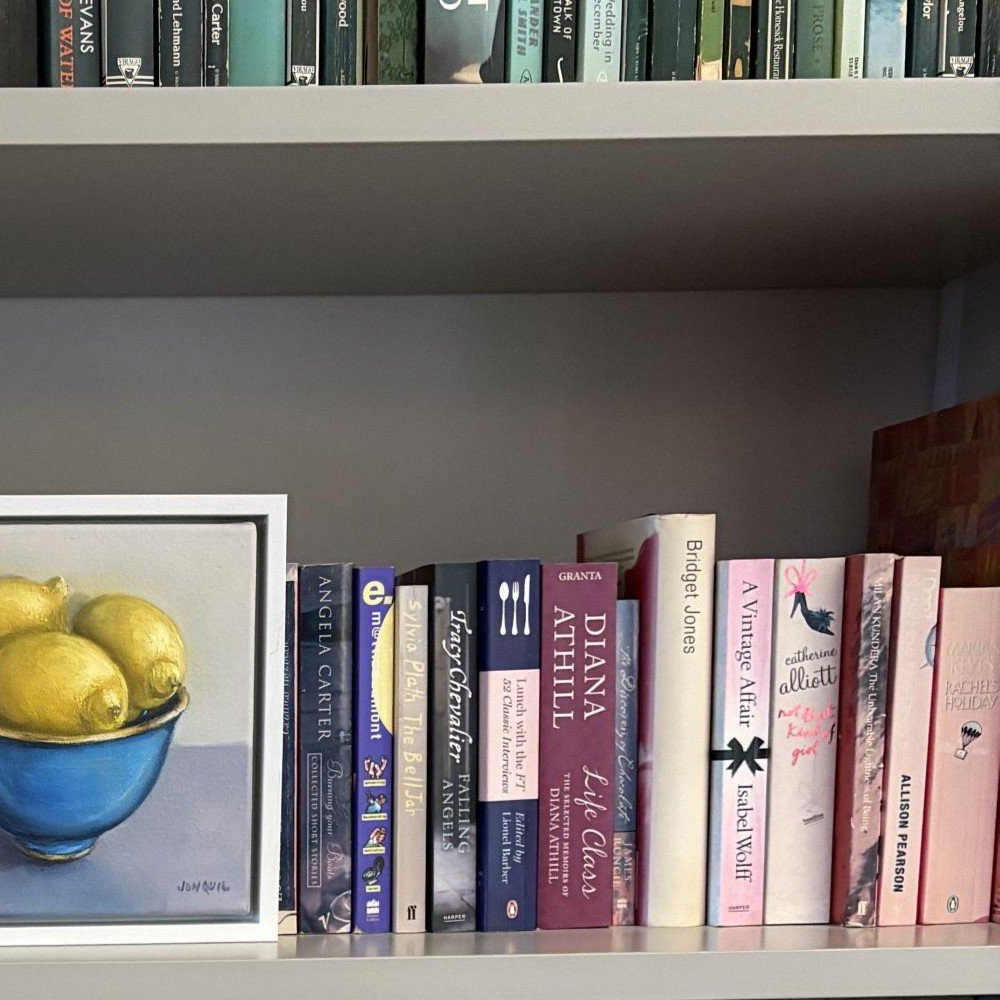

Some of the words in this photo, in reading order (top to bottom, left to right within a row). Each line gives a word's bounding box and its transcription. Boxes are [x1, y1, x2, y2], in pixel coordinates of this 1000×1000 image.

[171, 13, 184, 67] Lehmann
[211, 3, 224, 45] Carter
[562, 27, 572, 41] OF
[812, 4, 824, 53] PROSE
[558, 571, 602, 582] GRANTA
[680, 539, 704, 600] Bridget
[742, 580, 758, 596] A
[317, 576, 333, 655] ANGELA
[404, 598, 423, 653] Sylvia
[441, 608, 473, 666] Tracy
[682, 604, 702, 654] Jones
[734, 598, 759, 672] Vintage
[551, 604, 576, 731] ATHILL
[583, 612, 607, 721] DIANA
[779, 664, 839, 695] alliott
[785, 646, 839, 666] catherine
[317, 664, 333, 742] CARTER
[501, 677, 512, 694] 52
[514, 677, 528, 718] Lunch
[738, 675, 757, 728] Affair
[403, 712, 424, 744] The
[448, 666, 473, 763] Chevalier
[501, 695, 513, 734] Classic
[514, 720, 528, 749] with
[403, 751, 423, 787] Bell
[500, 735, 513, 795] Interviews
[514, 752, 528, 771] the
[515, 773, 527, 793] FT
[441, 778, 455, 852] ANGELS
[457, 773, 471, 855] FALLING
[548, 786, 561, 832] DIANA
[573, 764, 609, 822] Life
[736, 783, 755, 834] Isabel
[897, 773, 912, 829] ALLISON
[500, 811, 512, 846] Lionel
[514, 812, 525, 847] Edited
[500, 847, 512, 884] Barber
[512, 850, 525, 864] by
[547, 833, 560, 884] ATHILL
[580, 827, 607, 900] Class
[734, 834, 753, 882] Wolff
[893, 833, 909, 894] PEARSON
